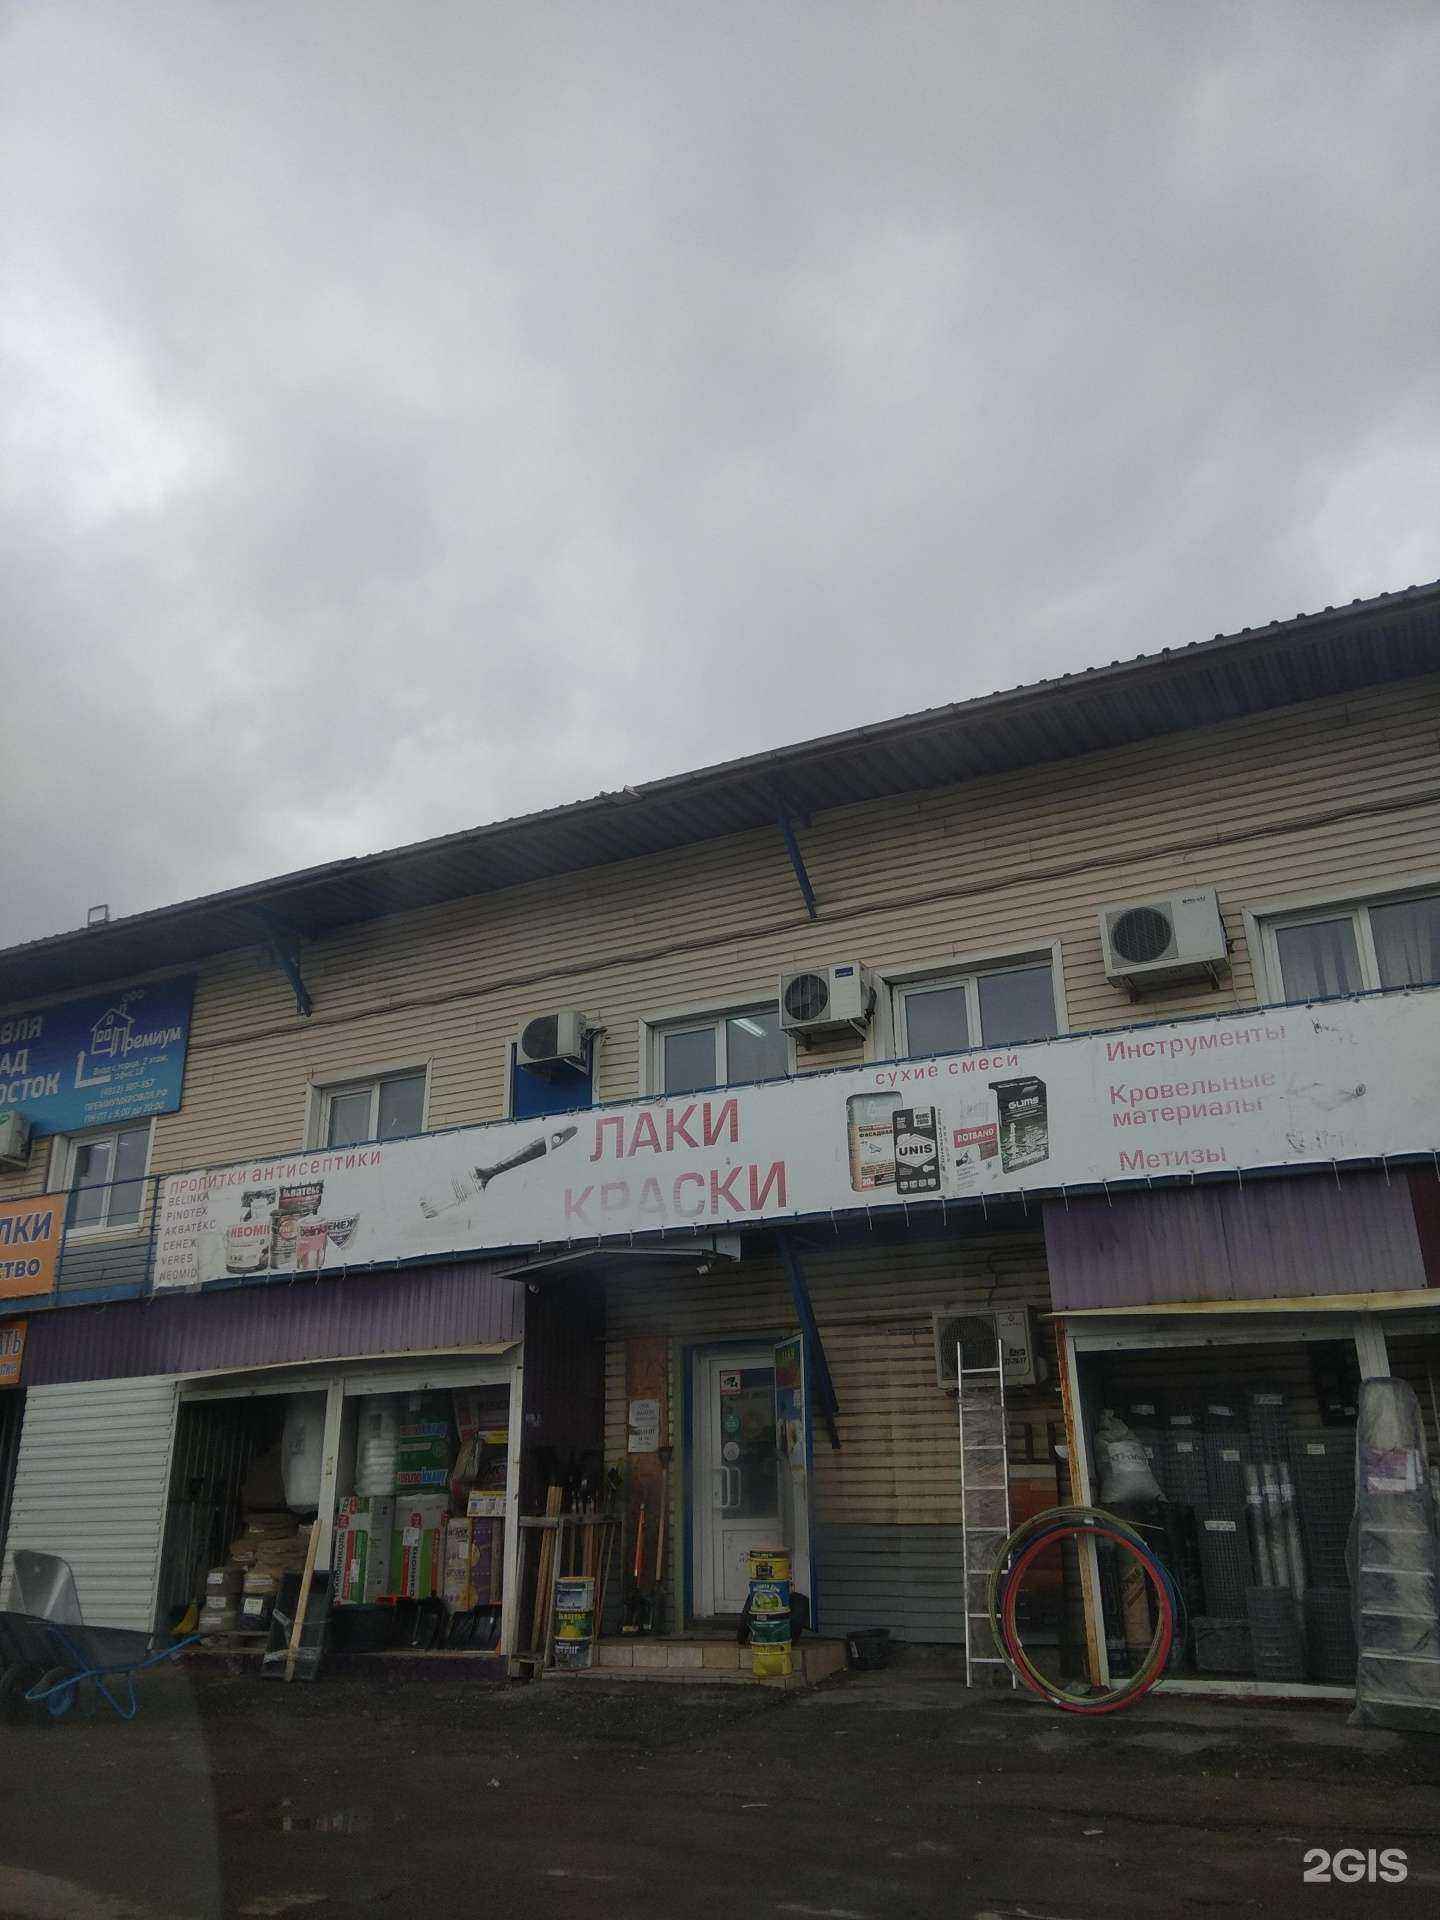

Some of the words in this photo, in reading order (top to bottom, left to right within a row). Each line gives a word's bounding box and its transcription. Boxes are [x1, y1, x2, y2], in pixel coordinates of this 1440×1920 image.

[1106, 1024, 1287, 1062] Инструменты
[875, 1066, 939, 1087] сухие
[948, 1055, 1019, 1075] смеси
[1109, 1071, 1275, 1106] Кровельные
[1112, 1097, 1263, 1127] материалы
[589, 1099, 739, 1162] ЛАКИ
[957, 1128, 995, 1142] ROTBAND
[898, 1144, 933, 1156] UNIS
[1119, 1147, 1226, 1171] Метизы
[170, 1172, 246, 1194] ПРОПИТКИ
[252, 1150, 383, 1182] антисептики
[563, 1160, 788, 1221] КРАСКИ
